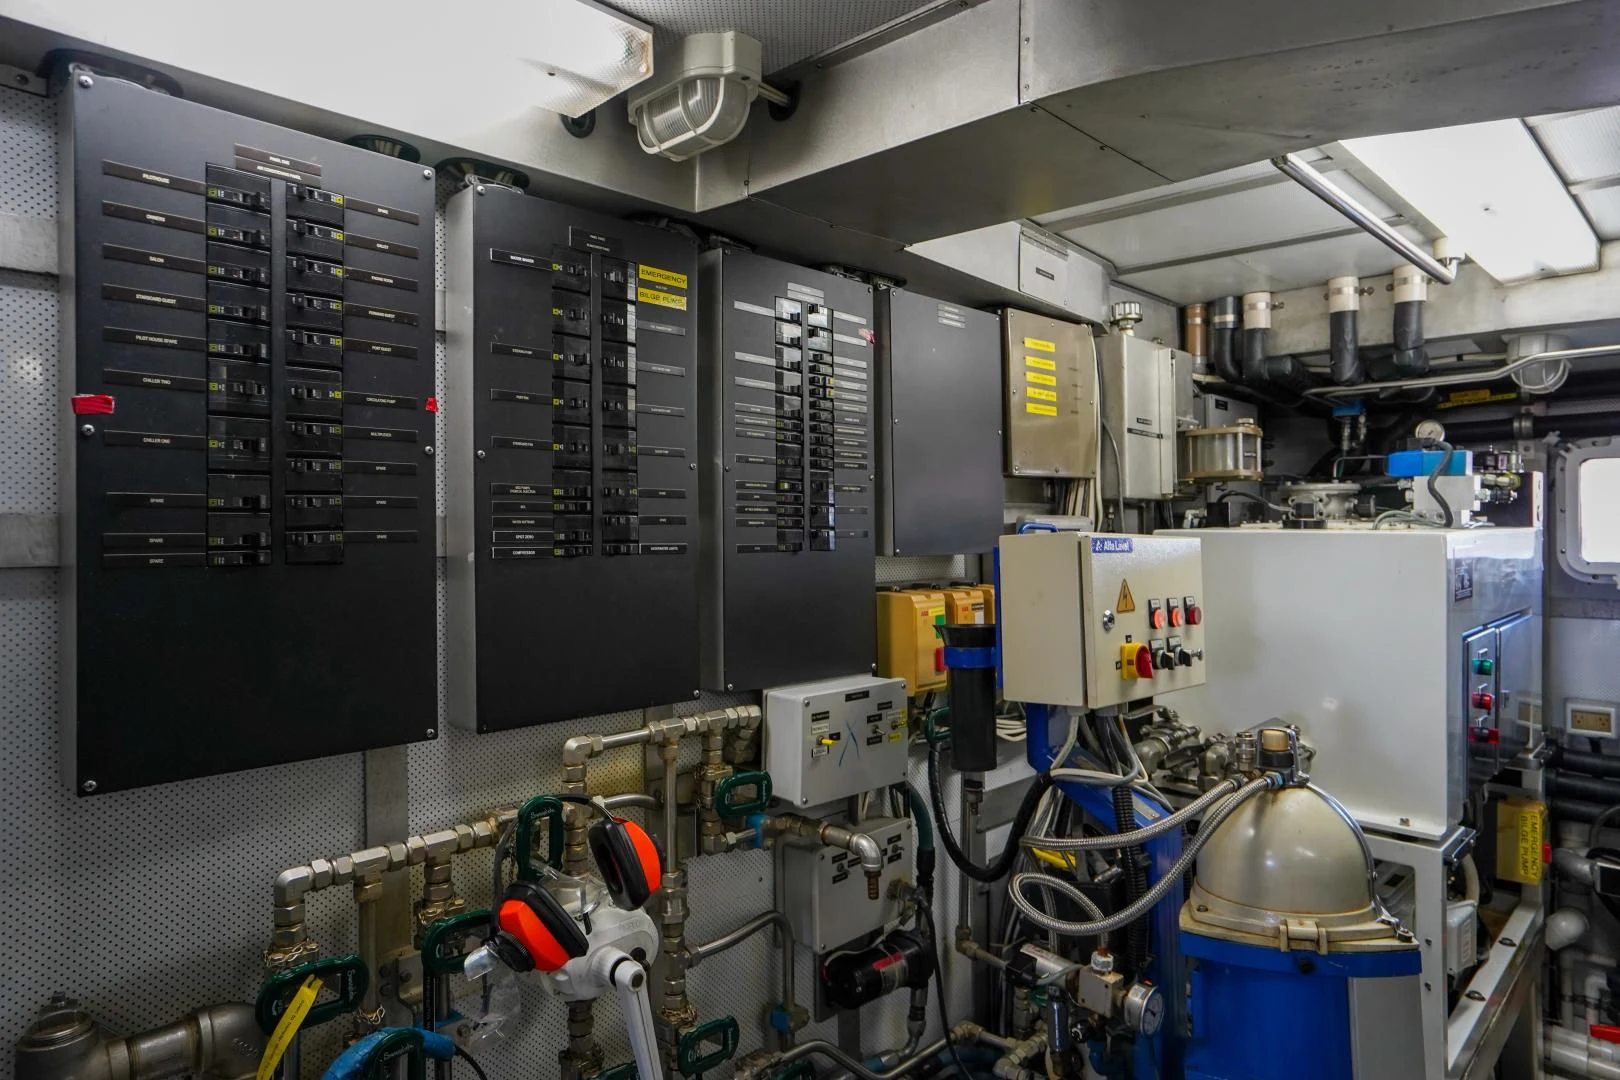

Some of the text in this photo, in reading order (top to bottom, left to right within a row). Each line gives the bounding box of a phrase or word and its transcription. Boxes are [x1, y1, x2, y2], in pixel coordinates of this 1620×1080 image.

[641, 268, 686, 284] EMERGENCY
[639, 291, 683, 305] BILGE PUMP
[1104, 540, 1130, 551] Alfa Laval
[1520, 815, 1529, 875] BILGE PUMP
[1530, 815, 1539, 878] EMERGENCY
